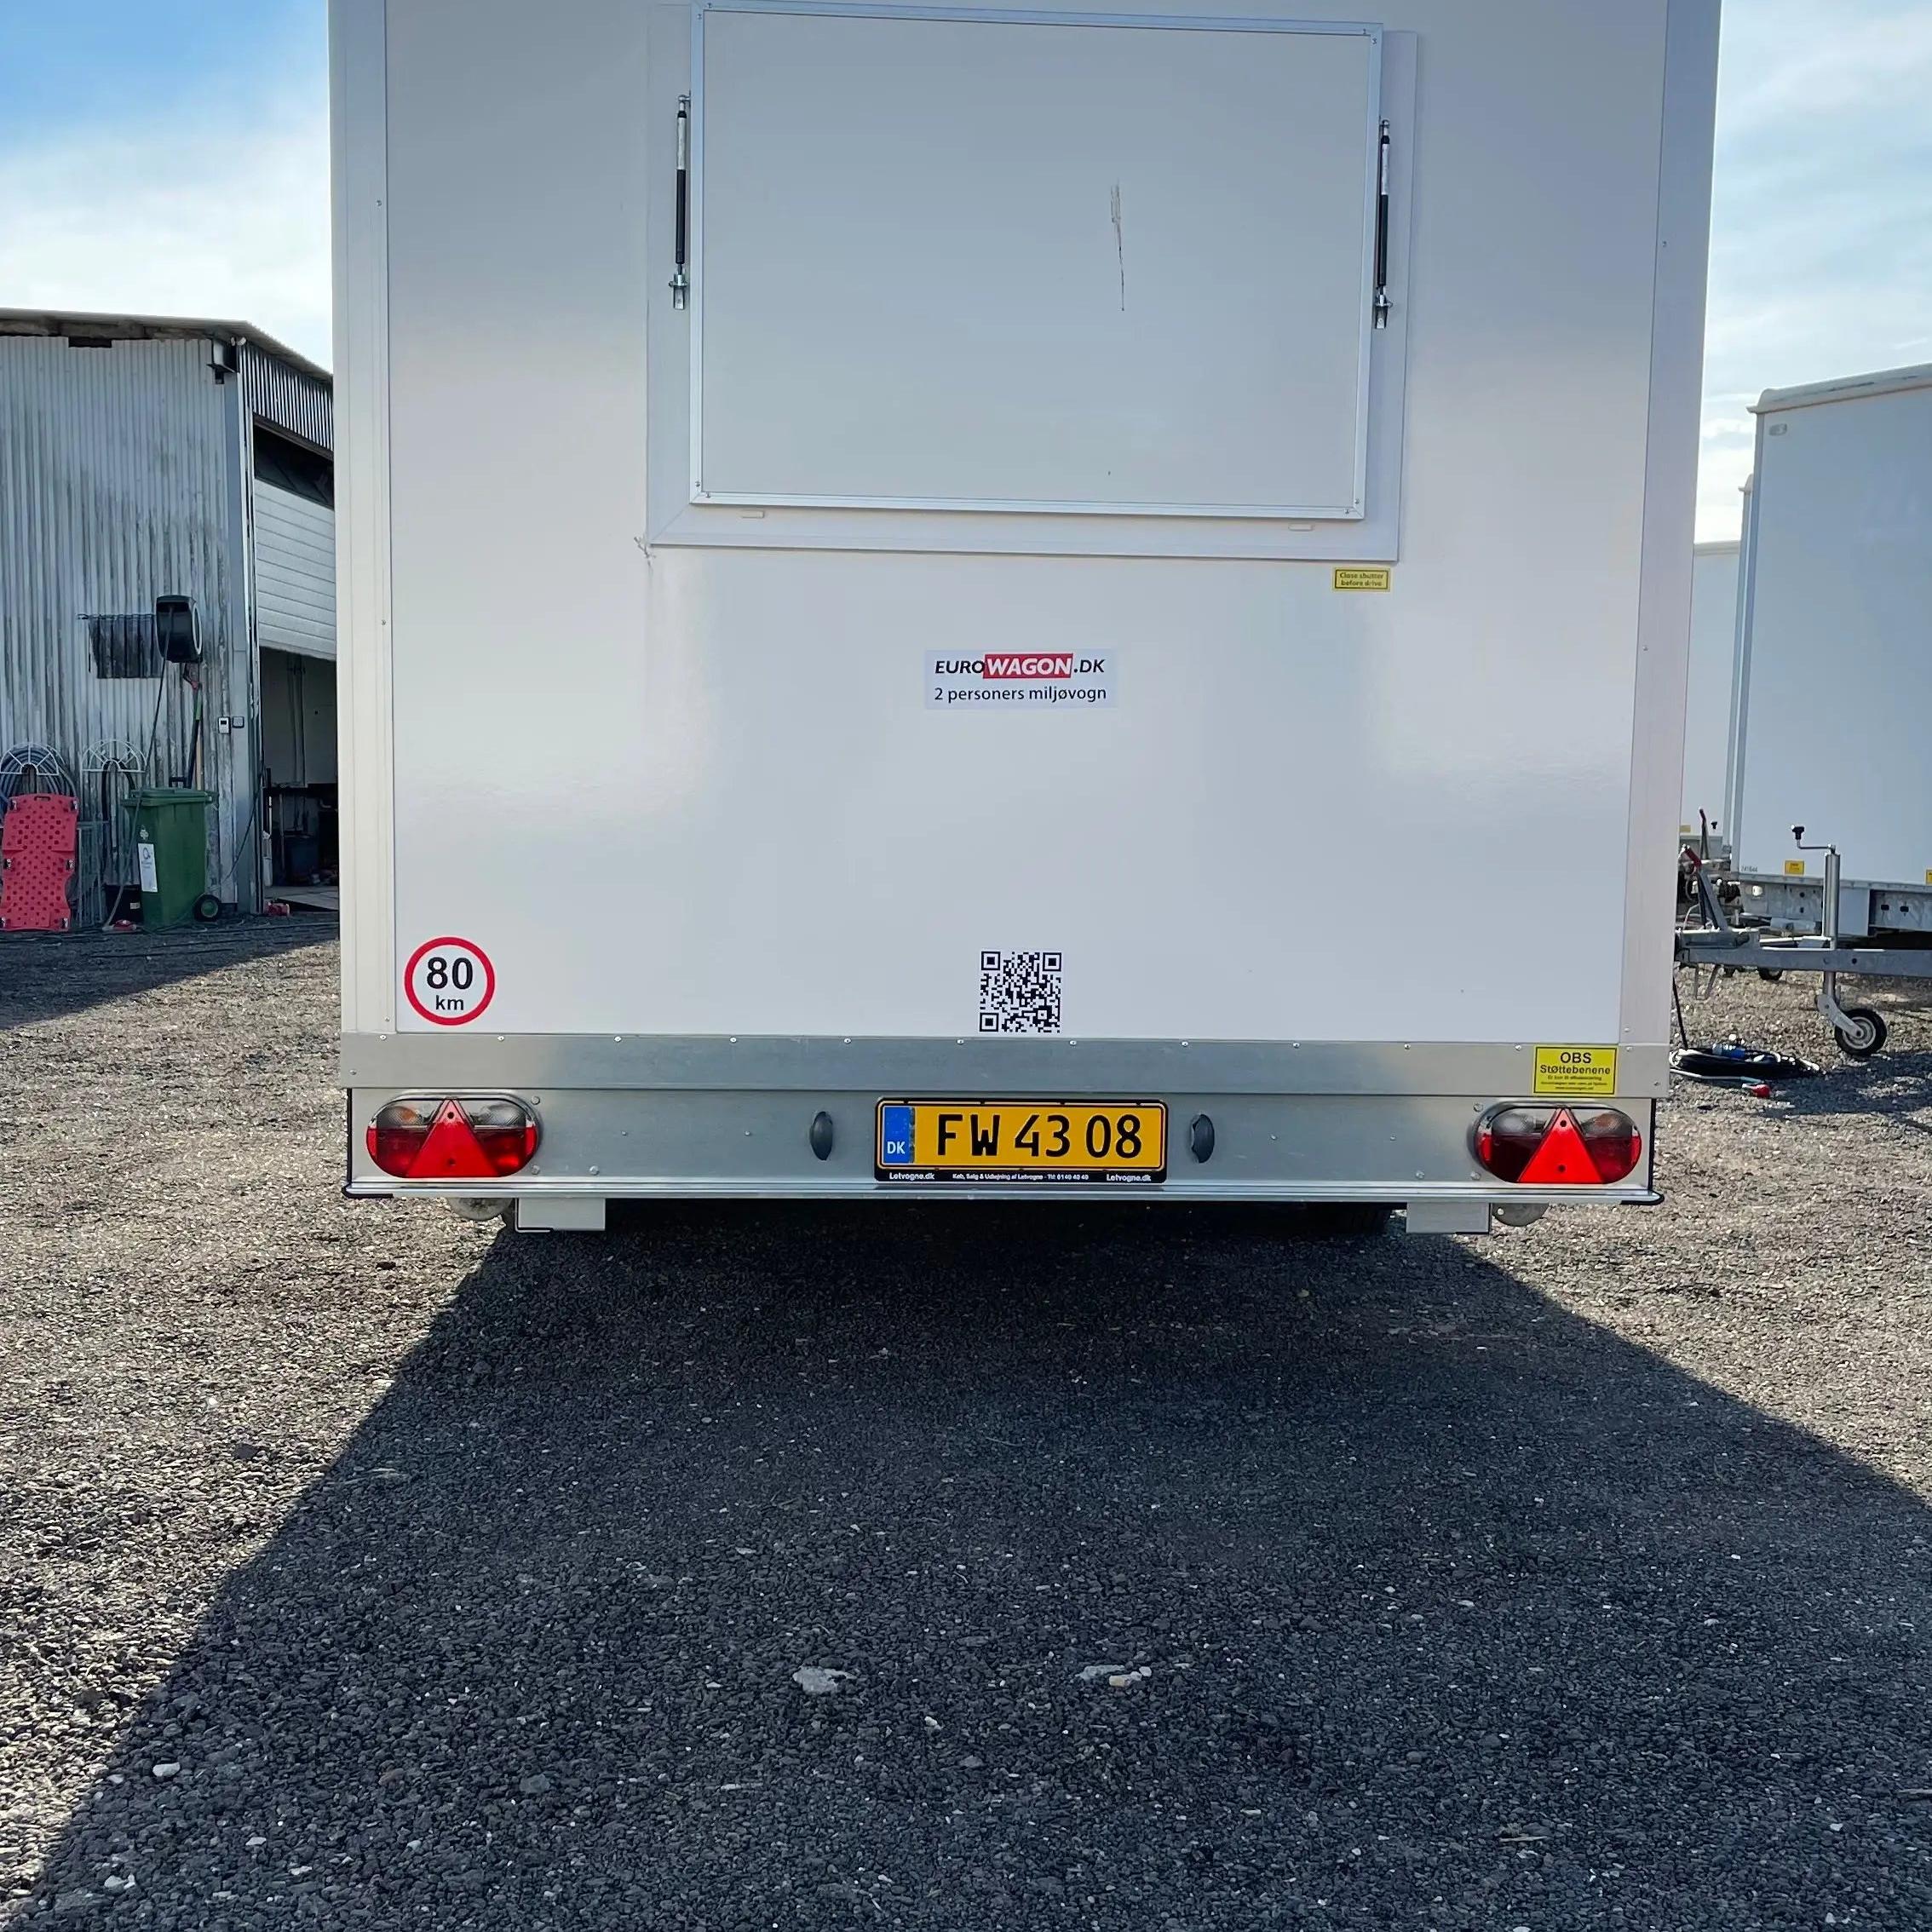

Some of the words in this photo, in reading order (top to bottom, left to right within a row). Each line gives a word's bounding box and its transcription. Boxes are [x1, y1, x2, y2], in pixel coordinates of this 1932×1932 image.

[934, 657, 1106, 676] EUROWAGON.DK
[934, 687, 943, 700] 2
[947, 688, 1025, 704] personers
[1029, 686, 1107, 704] miljøvogn
[427, 957, 473, 990] 80
[435, 994, 464, 1011] km
[1560, 1051, 1592, 1064] OBS
[1539, 1064, 1611, 1075] Støttebenene
[937, 1113, 1001, 1156] FW
[1015, 1114, 1071, 1158] 43
[1086, 1114, 1142, 1159] 08
[887, 1141, 906, 1155] DK
[888, 1172, 935, 1182] Letvogne.dk
[1107, 1173, 1152, 1182] Letvogne.dk
